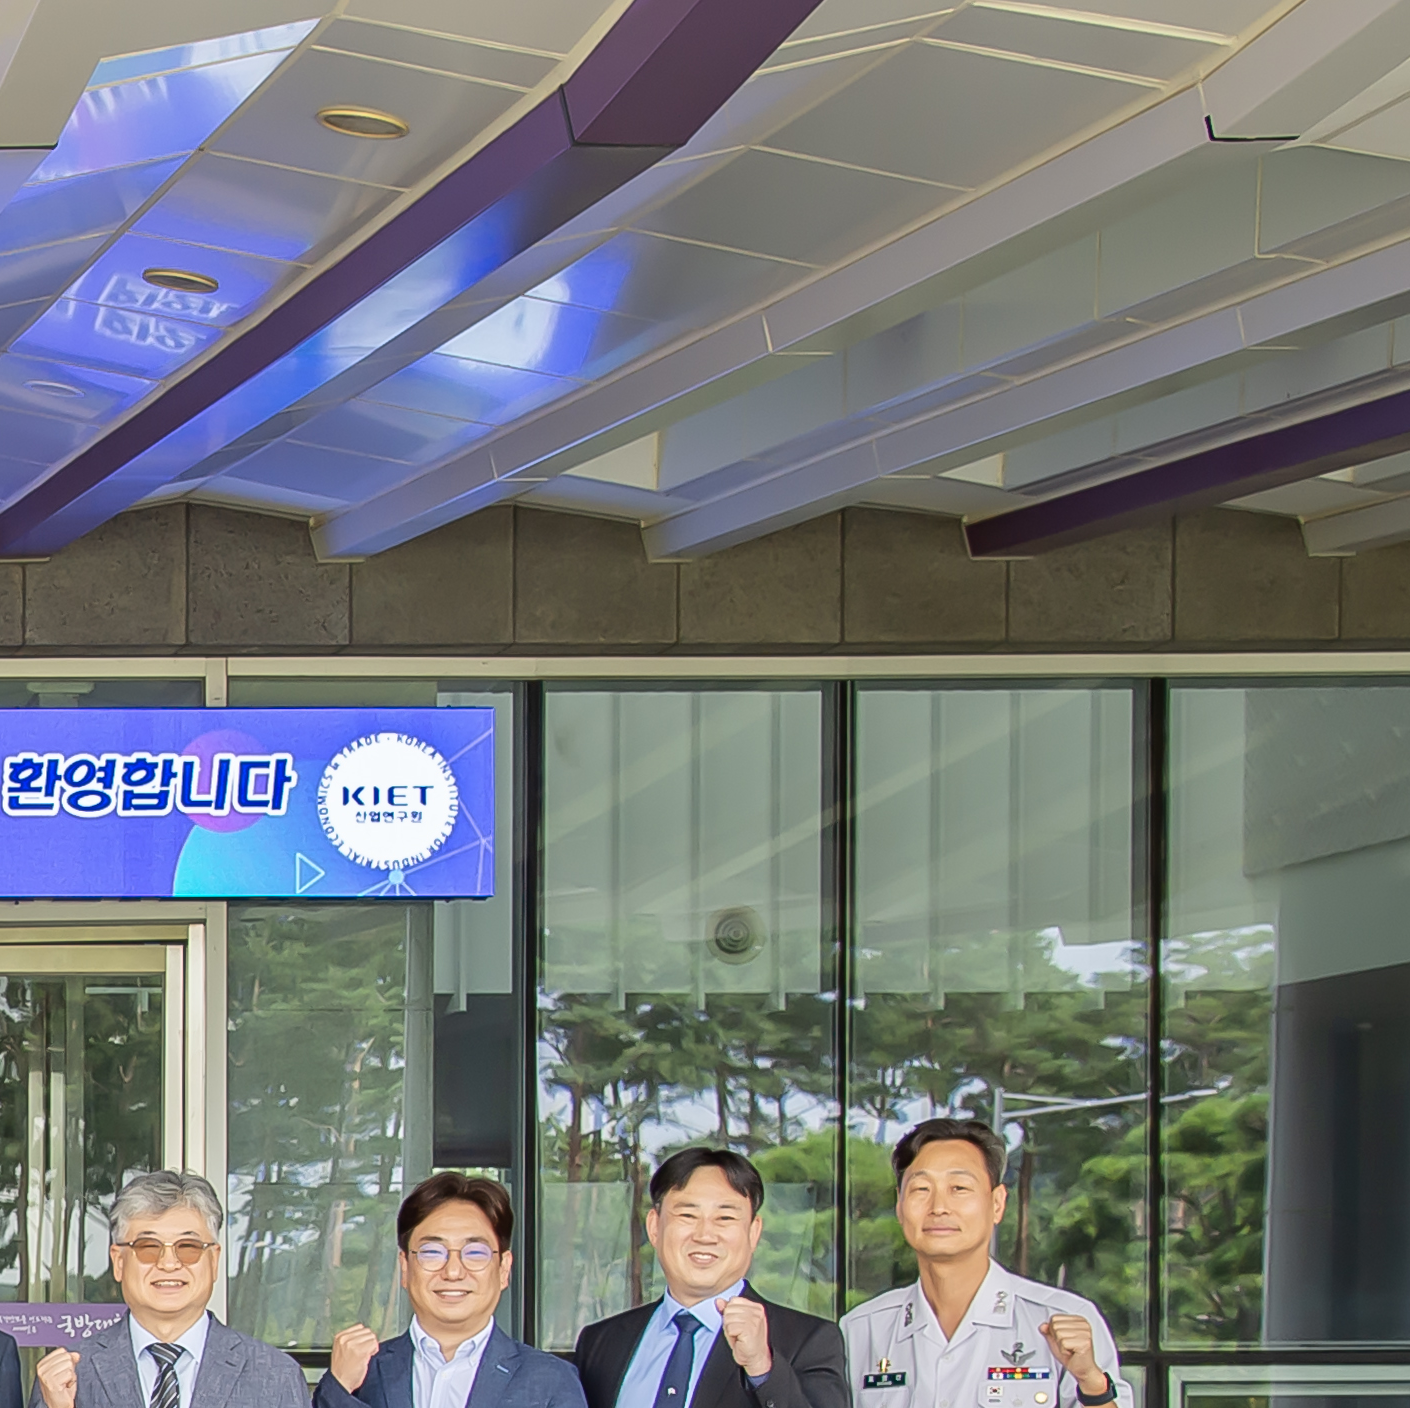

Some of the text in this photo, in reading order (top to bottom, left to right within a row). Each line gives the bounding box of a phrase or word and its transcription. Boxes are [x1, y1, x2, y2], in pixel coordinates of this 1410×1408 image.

[9, 757, 293, 812] 환영합니다
[342, 785, 435, 807] KIET
[354, 810, 423, 824] 산업연구원
[56, 1312, 122, 1338] 국방대
